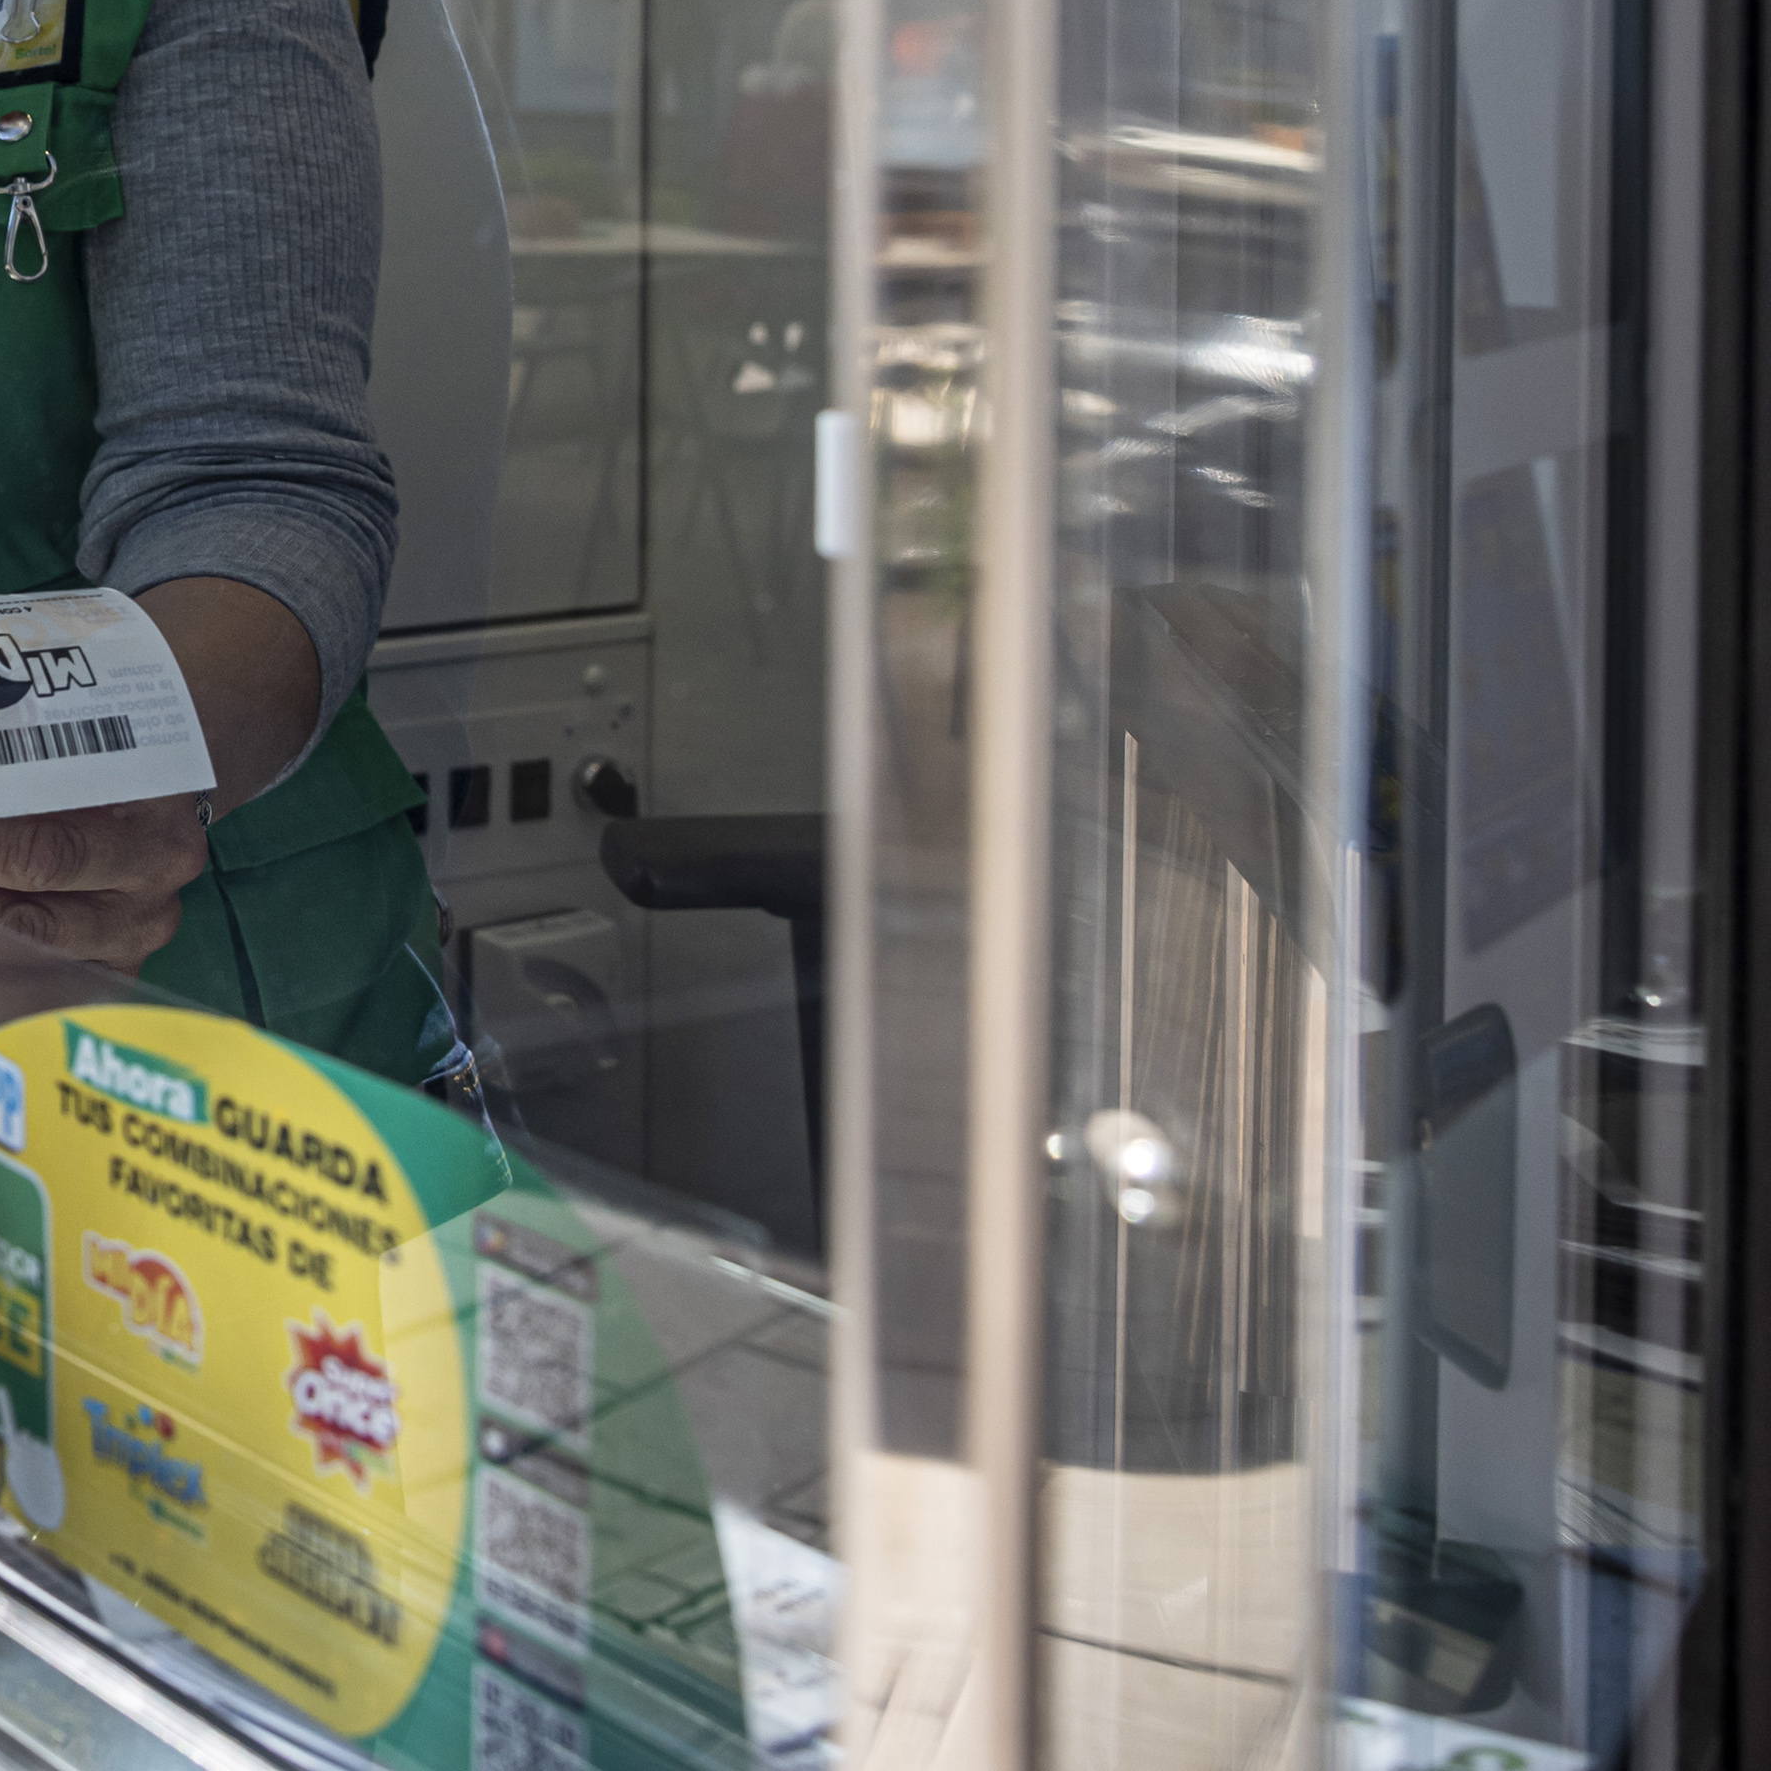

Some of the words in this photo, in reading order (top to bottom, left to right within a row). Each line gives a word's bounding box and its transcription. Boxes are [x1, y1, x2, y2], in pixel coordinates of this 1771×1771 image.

[25, 646, 97, 698] MI
[55, 1080, 113, 1136] TUS
[121, 1112, 401, 1268] COMBINACIONES
[72, 1033, 196, 1122] Ahora
[214, 1094, 390, 1207] GUARDA
[110, 1154, 278, 1264] FAVORITAS
[287, 1238, 334, 1293] DE
